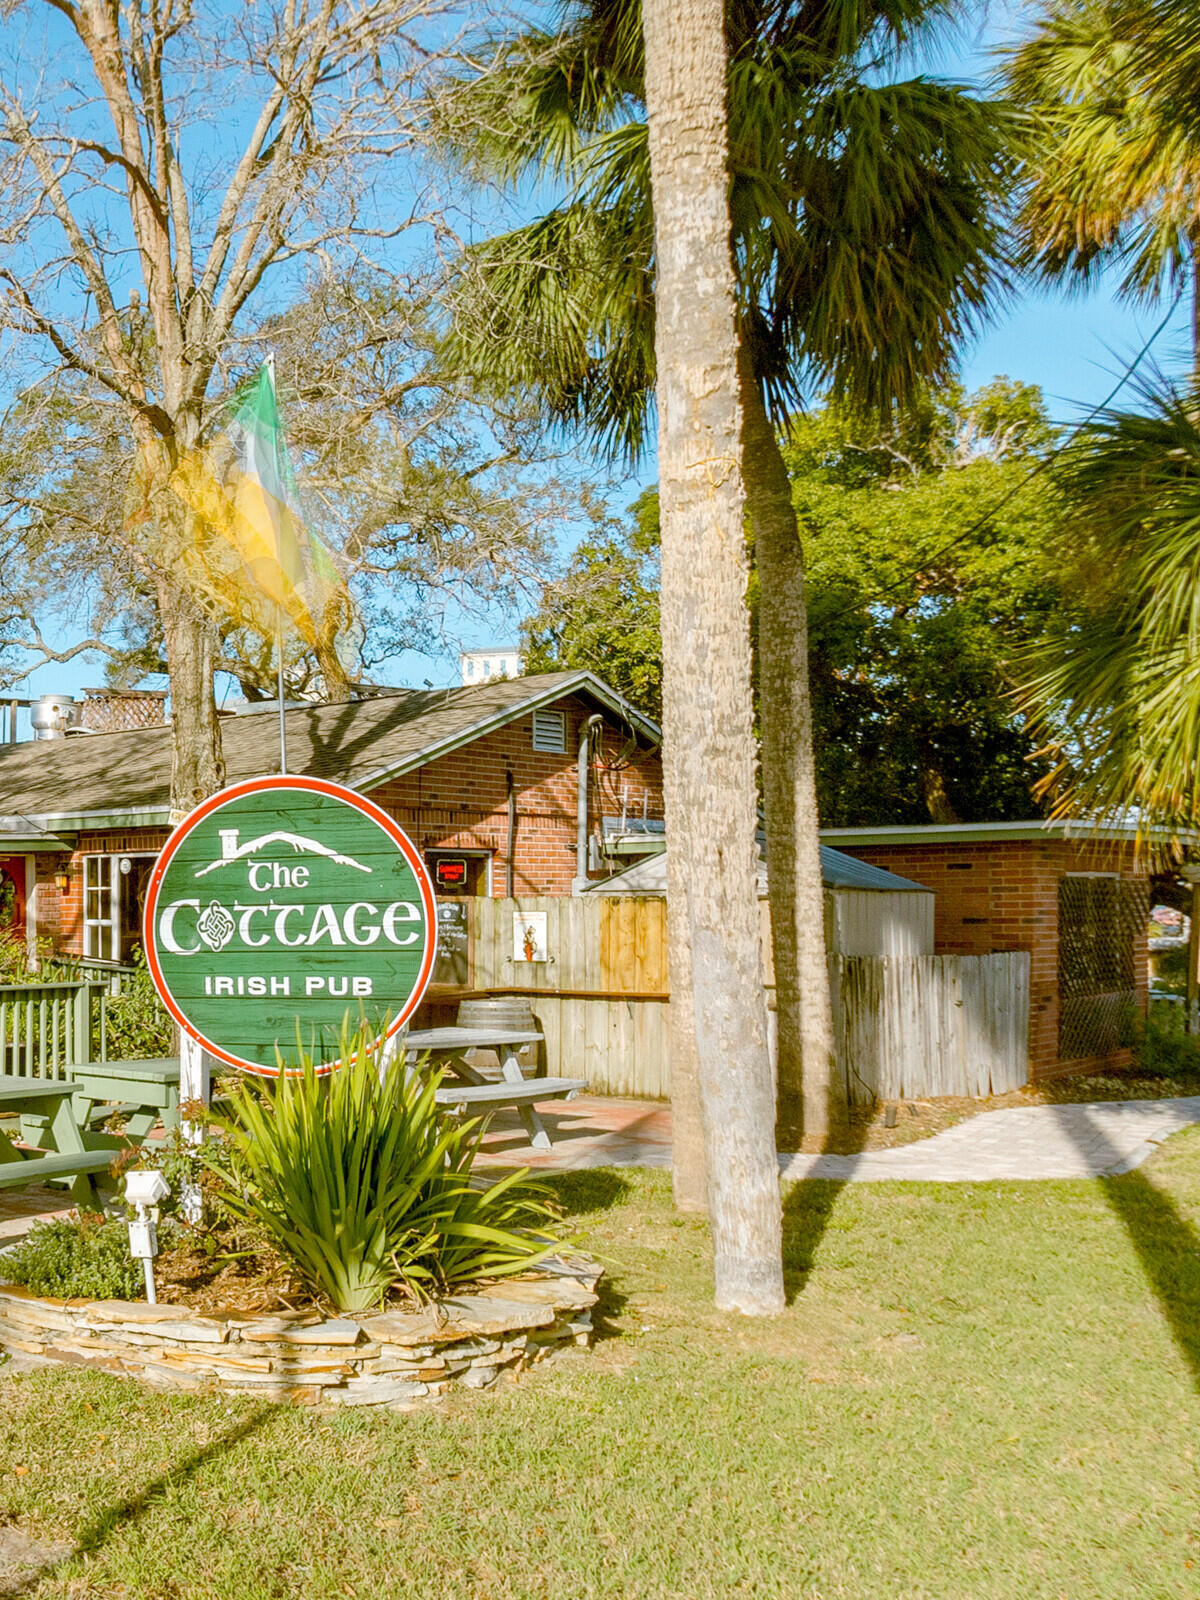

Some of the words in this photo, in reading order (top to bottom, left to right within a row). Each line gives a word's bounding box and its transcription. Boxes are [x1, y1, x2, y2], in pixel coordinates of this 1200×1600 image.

[247, 858, 310, 892] The
[204, 976, 290, 996] IRISH
[305, 976, 373, 996] PUB
